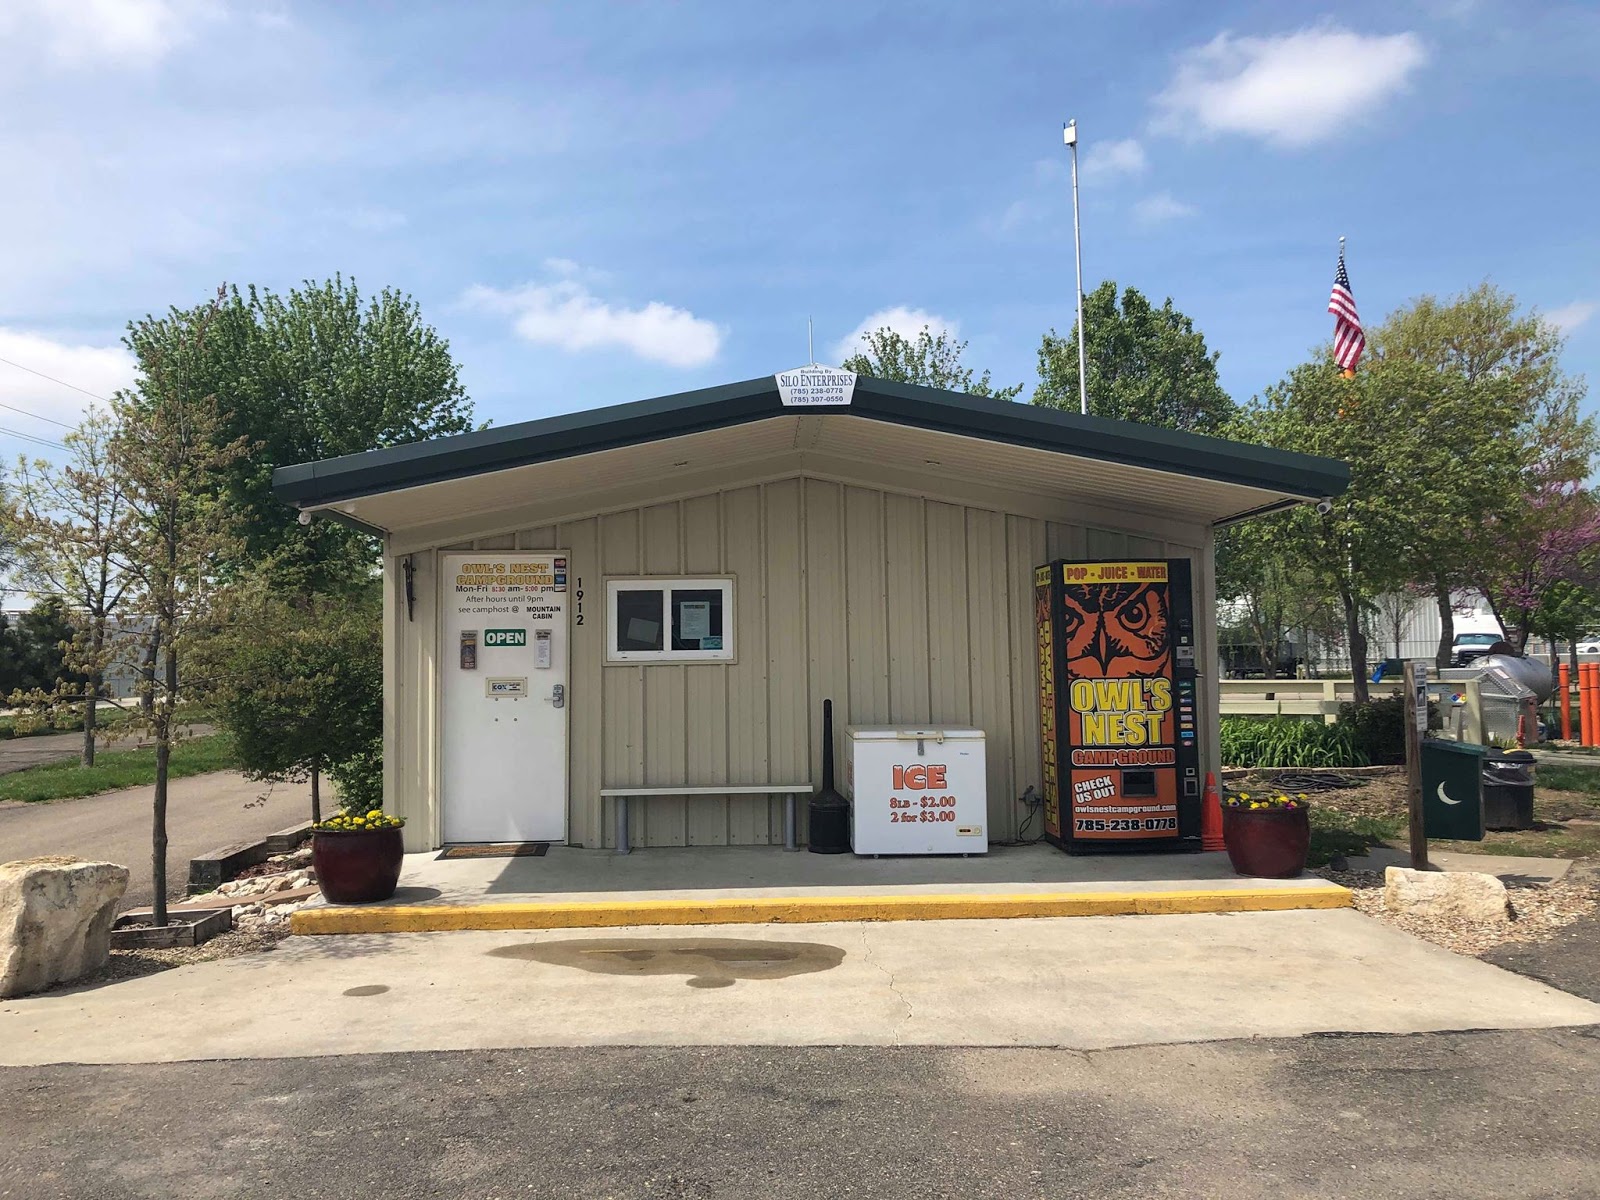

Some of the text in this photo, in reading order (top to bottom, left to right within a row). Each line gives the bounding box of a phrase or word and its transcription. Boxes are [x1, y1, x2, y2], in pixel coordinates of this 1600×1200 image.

[780, 374, 853, 387] SILO ENTERPRISES
[462, 563, 506, 574] OWL'S
[509, 563, 549, 574] NEST
[1066, 567, 1087, 580] POP
[1098, 566, 1128, 579] JUICE
[1136, 566, 1167, 579] WATER
[456, 575, 554, 586] CAMPGROUND
[526, 595, 544, 604] 9pm
[472, 605, 509, 614] camphost
[511, 605, 520, 613] @
[486, 632, 525, 644] OPEN
[1070, 677, 1172, 713] OWL'S
[1082, 711, 1165, 746] NEST
[1072, 748, 1176, 766] CAMPGROUND
[893, 764, 947, 790] ICE
[1074, 775, 1113, 793] CHECK
[1075, 785, 1116, 804] US OUT
[920, 795, 956, 808] $2.00
[1075, 804, 1177, 814] owlsnestcampground.com
[890, 810, 956, 823] 2 for $3.00
[1075, 817, 1177, 831] 785-238-0778
